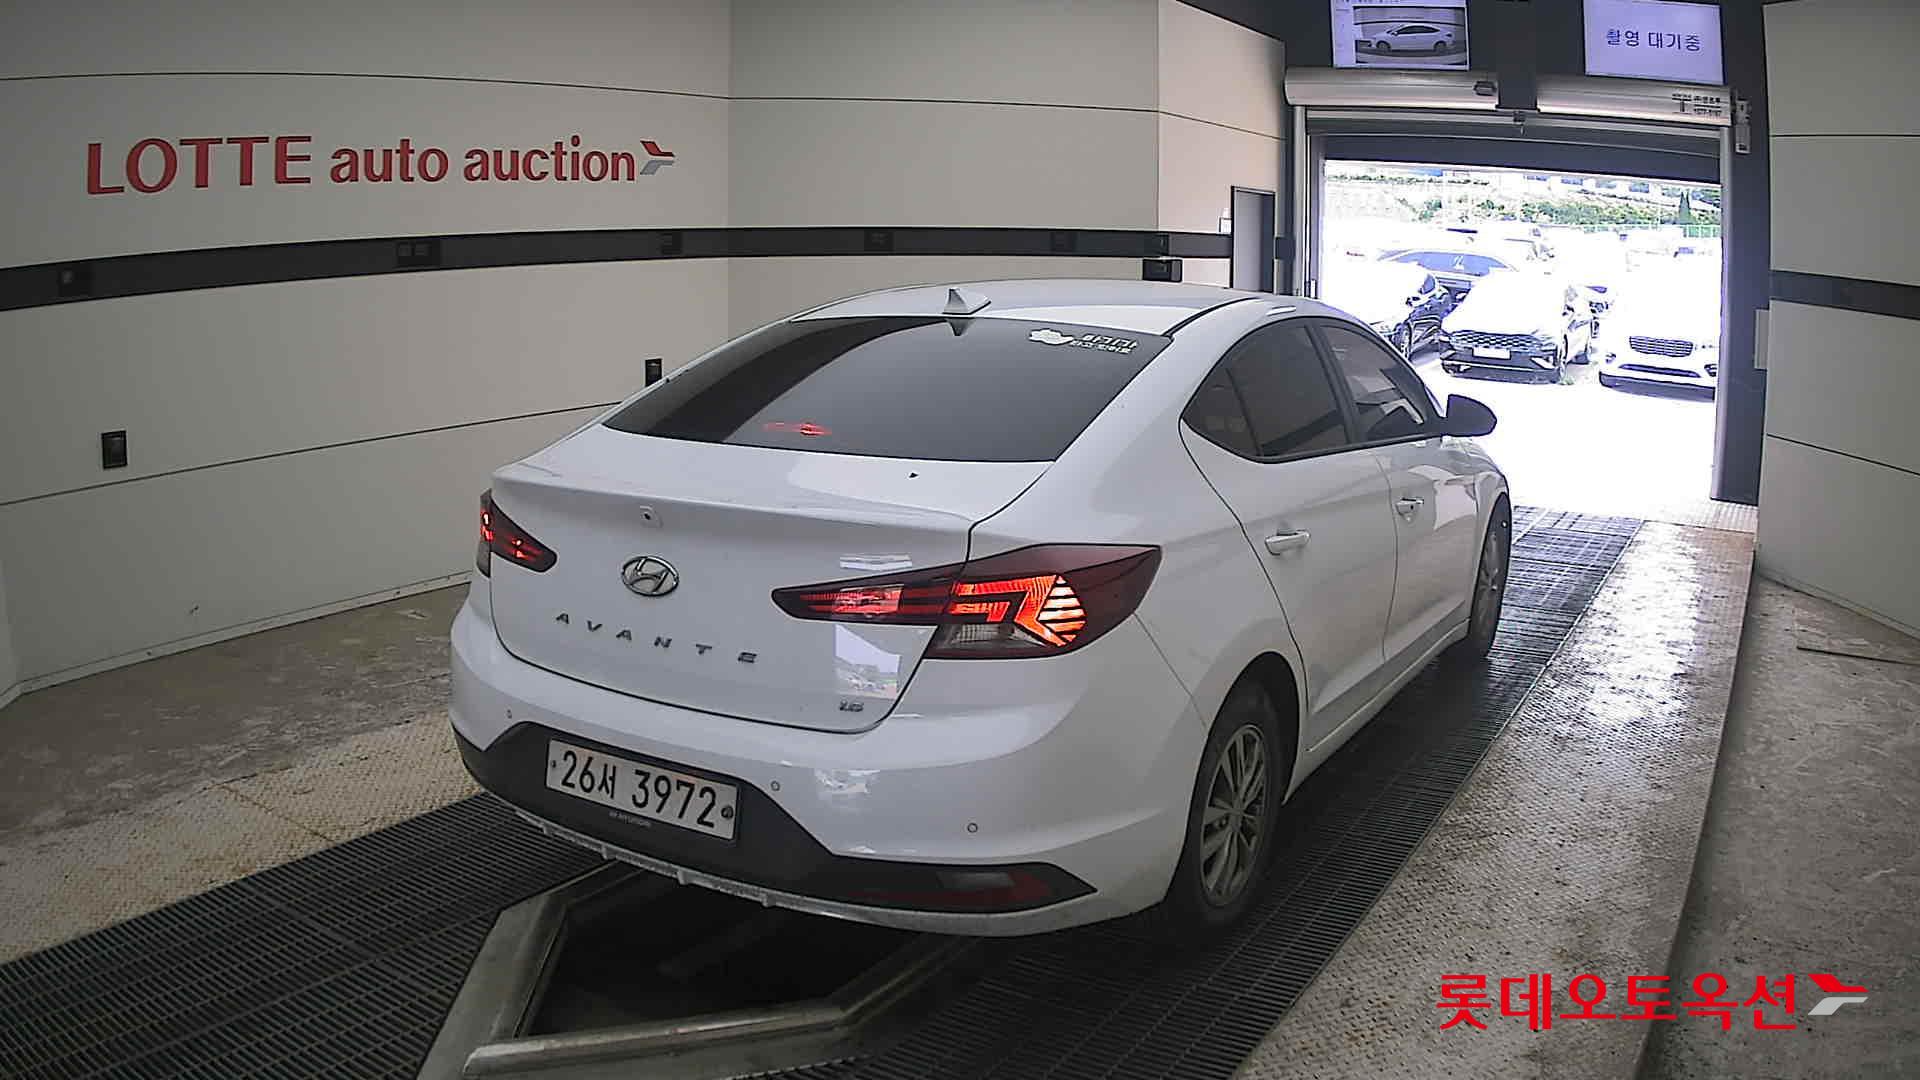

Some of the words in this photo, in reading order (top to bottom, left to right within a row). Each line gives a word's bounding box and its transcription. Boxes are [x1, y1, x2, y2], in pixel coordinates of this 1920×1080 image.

[1606, 28, 1640, 48] 촬영
[1648, 31, 1701, 52] 대기중
[88, 136, 313, 194] LOTTE
[330, 139, 451, 184] auto
[463, 135, 638, 183] auction
[555, 612, 758, 664] AVANTE
[561, 749, 617, 799] 26서
[631, 769, 717, 828] 3972
